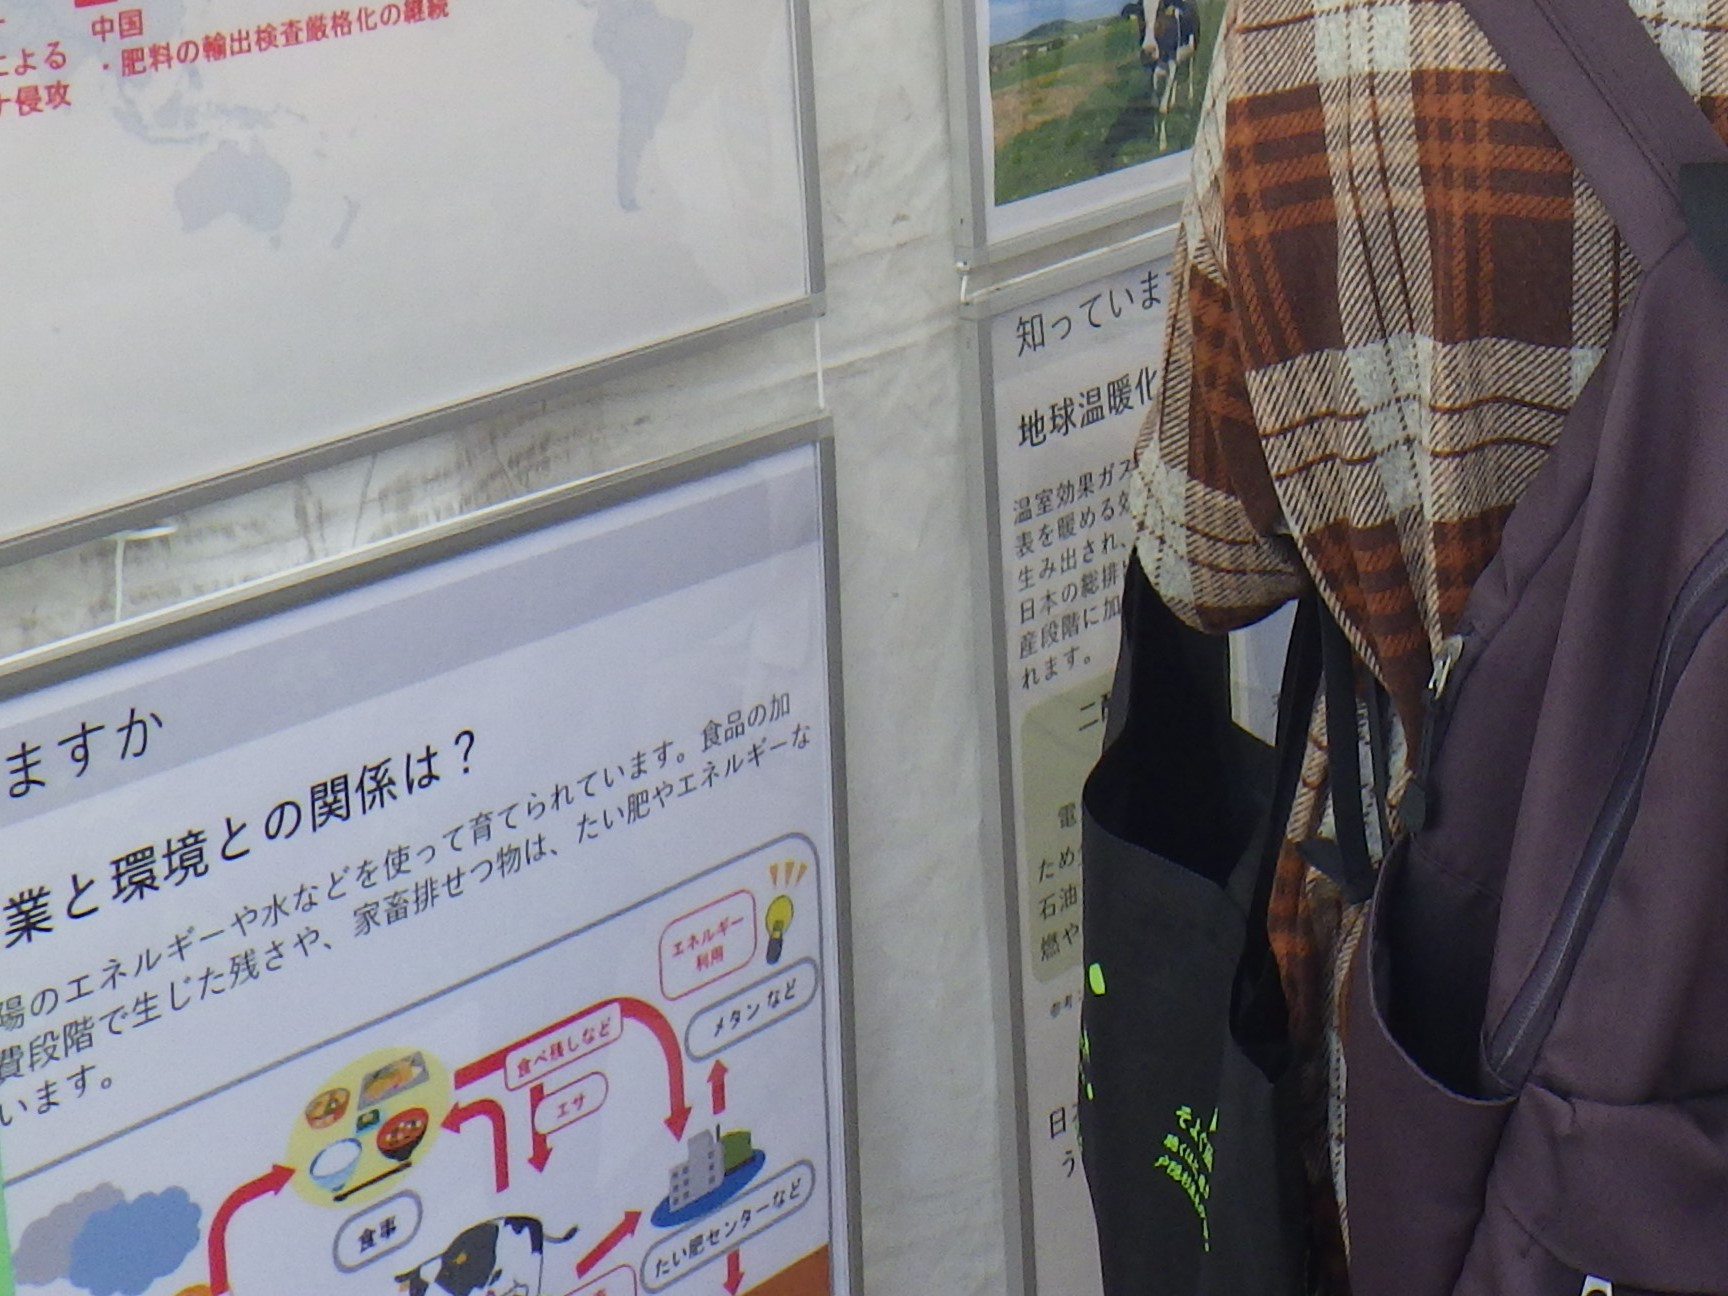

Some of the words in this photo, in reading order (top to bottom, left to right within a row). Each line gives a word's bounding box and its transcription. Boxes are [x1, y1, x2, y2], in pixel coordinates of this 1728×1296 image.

[91, 8, 144, 43] 中国
[1016, 270, 1172, 358] 知っていま
[1021, 645, 1092, 690] れます。
[5, 707, 163, 798] ますか
[3, 728, 476, 950] 業と環境との関係は？
[556, 1091, 587, 1119] エサ
[357, 1218, 397, 1254] 食事
[655, 1178, 803, 1280] たい肥センターなど
